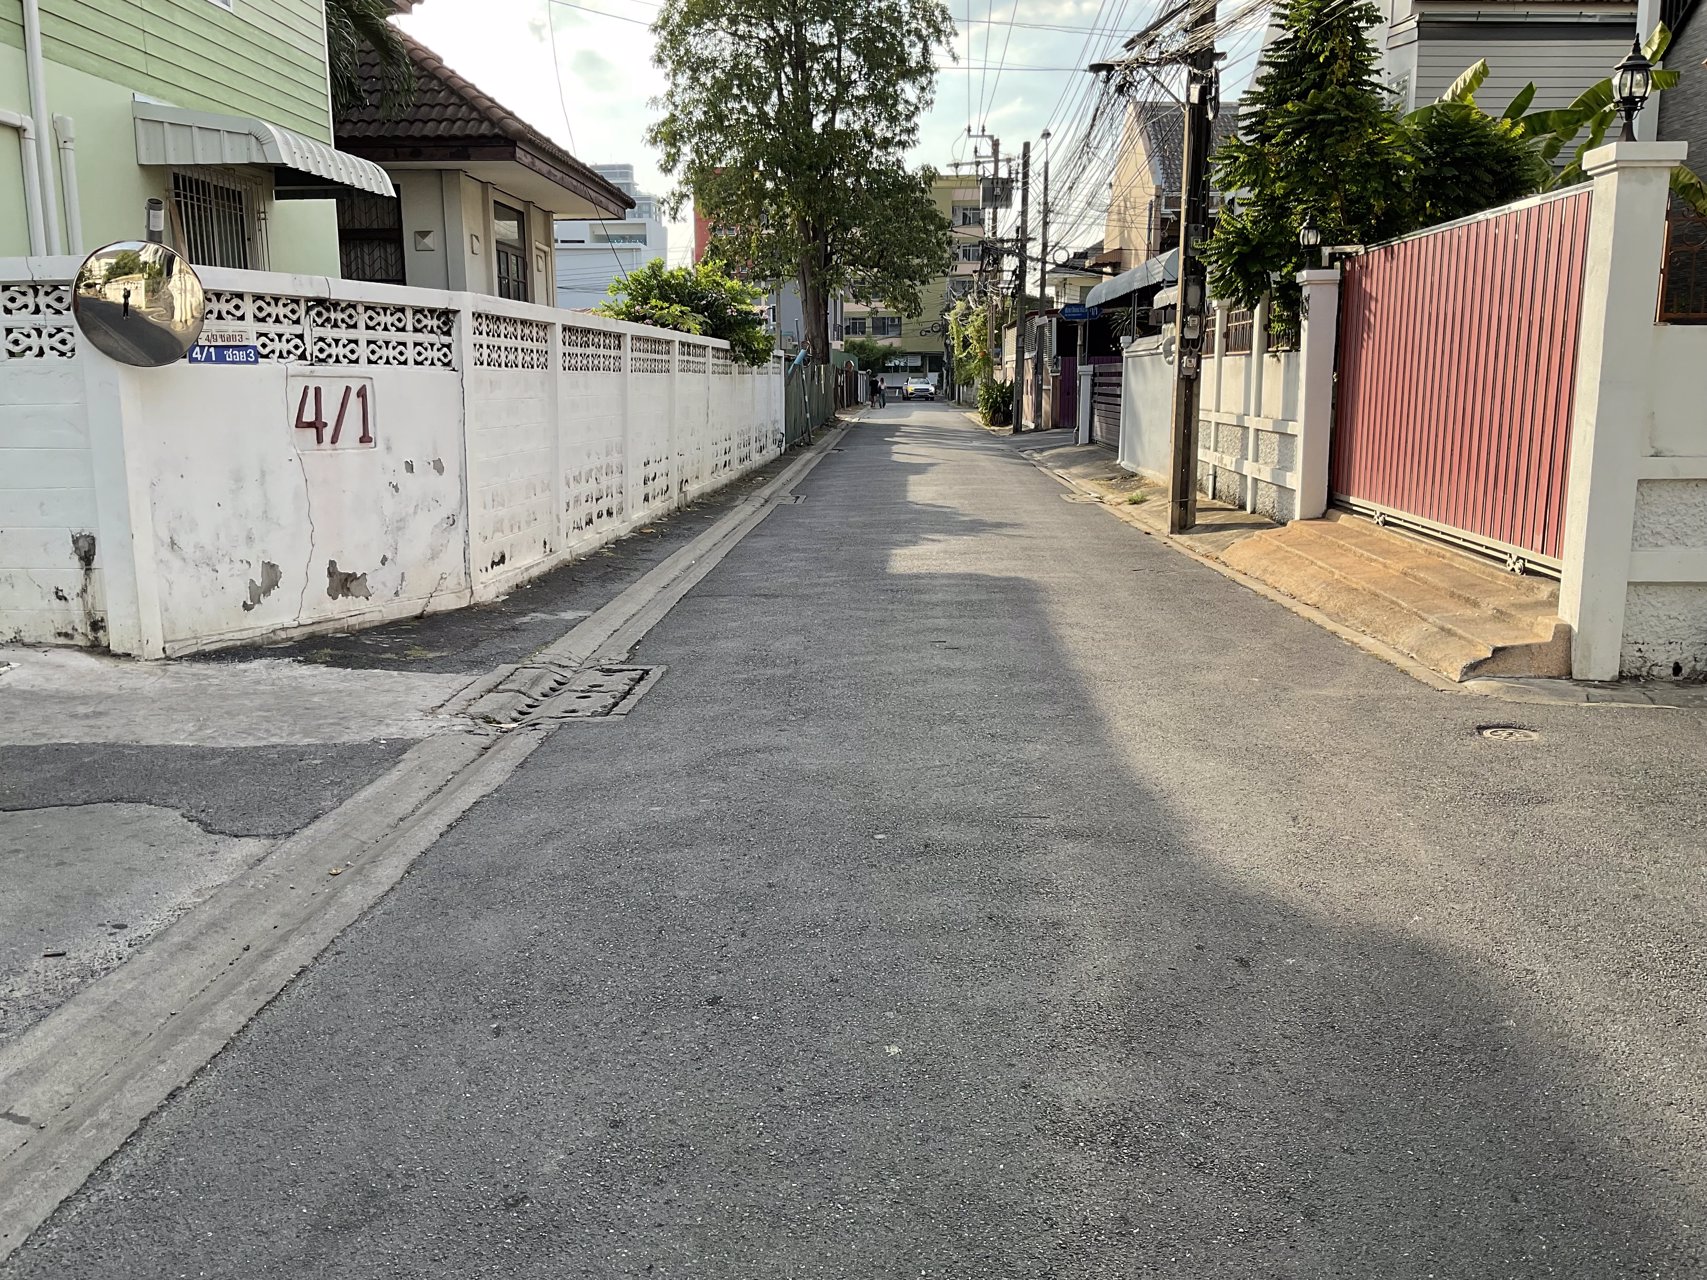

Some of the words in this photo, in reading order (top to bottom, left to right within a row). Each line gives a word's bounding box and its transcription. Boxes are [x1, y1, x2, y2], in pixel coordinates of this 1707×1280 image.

[192, 346, 216, 361] 4/1
[224, 348, 255, 361] ซอย3
[295, 384, 373, 444] 4/1
